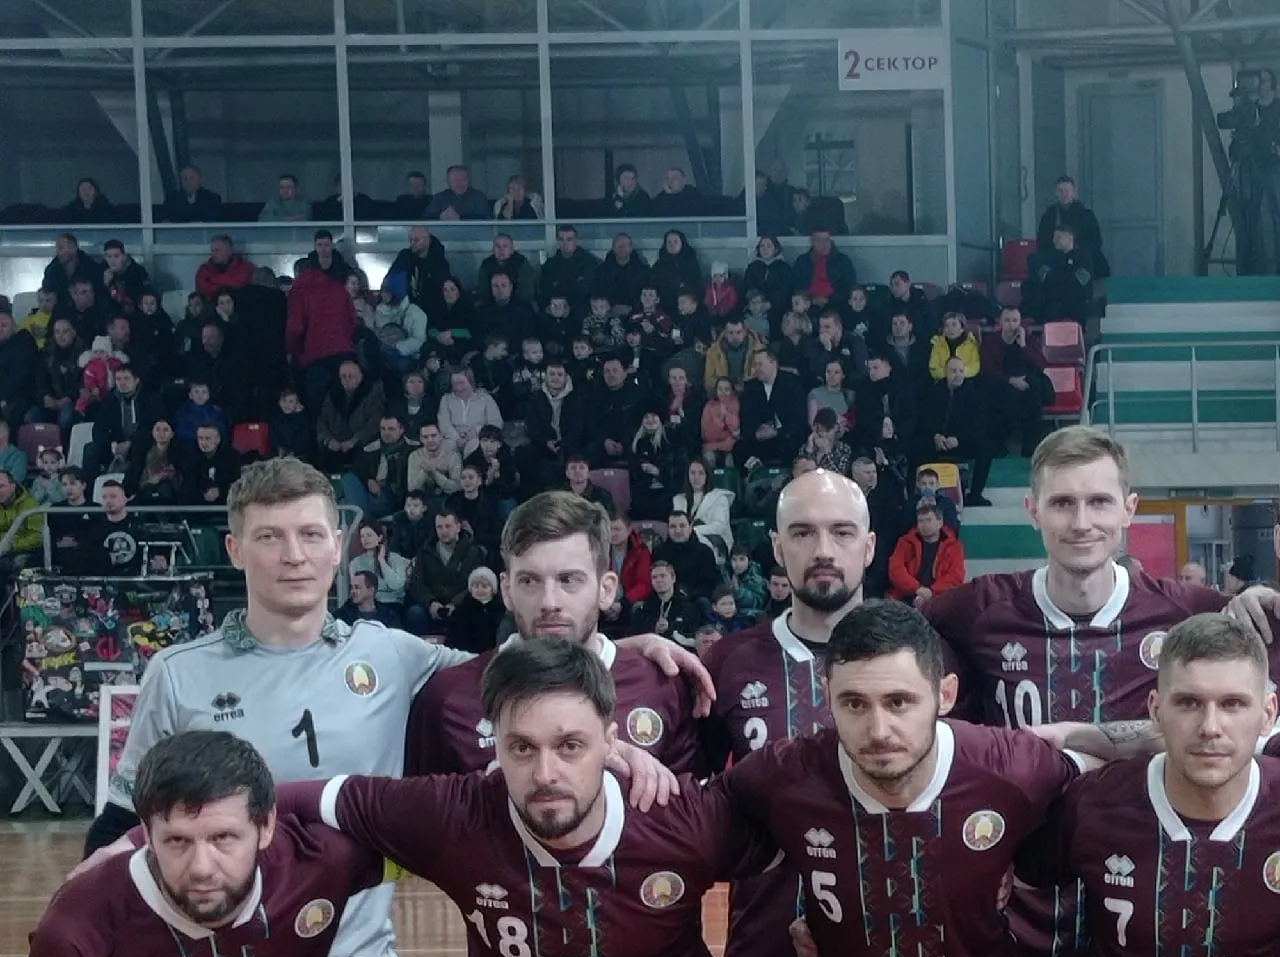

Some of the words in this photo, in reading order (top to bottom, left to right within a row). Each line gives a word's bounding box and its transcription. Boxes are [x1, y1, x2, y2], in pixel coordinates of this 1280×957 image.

[844, 49, 861, 79] 2
[864, 56, 938, 71] СЕКТОР
[995, 679, 1042, 730] 10
[291, 708, 320, 768] 1
[811, 869, 843, 923] 5
[1103, 897, 1134, 947] 7
